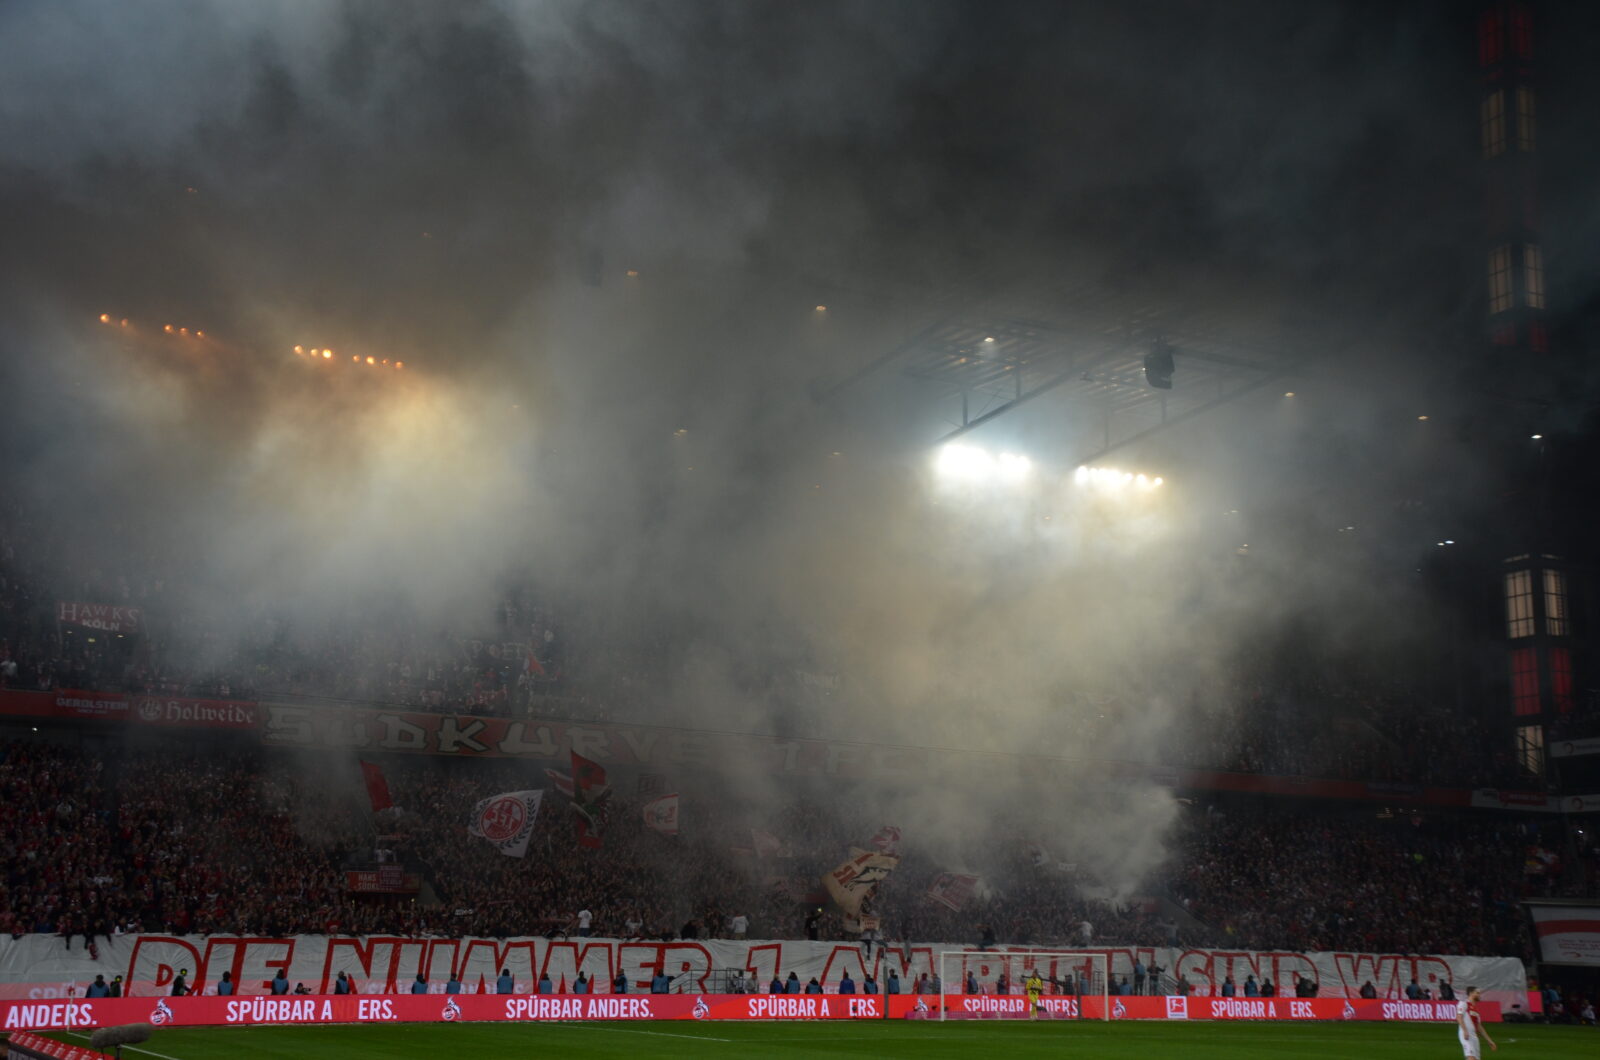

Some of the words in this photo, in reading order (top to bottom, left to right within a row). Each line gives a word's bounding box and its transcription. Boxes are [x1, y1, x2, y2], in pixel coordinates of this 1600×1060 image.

[59, 602, 140, 627] HAWKS
[82, 618, 120, 631] KÖLN
[122, 936, 296, 997] DIE
[317, 938, 713, 996] NUMMER
[4, 1004, 98, 1028] ANDERS.
[226, 996, 315, 1022] SPÜRBAR
[505, 996, 588, 1019] SPÜRBAR
[588, 998, 654, 1018] ANDERS.
[749, 995, 816, 1017] SPÜRBAR
[1211, 998, 1265, 1017] SPÜRBAR
[1382, 1000, 1434, 1020] SPÜRBAR
